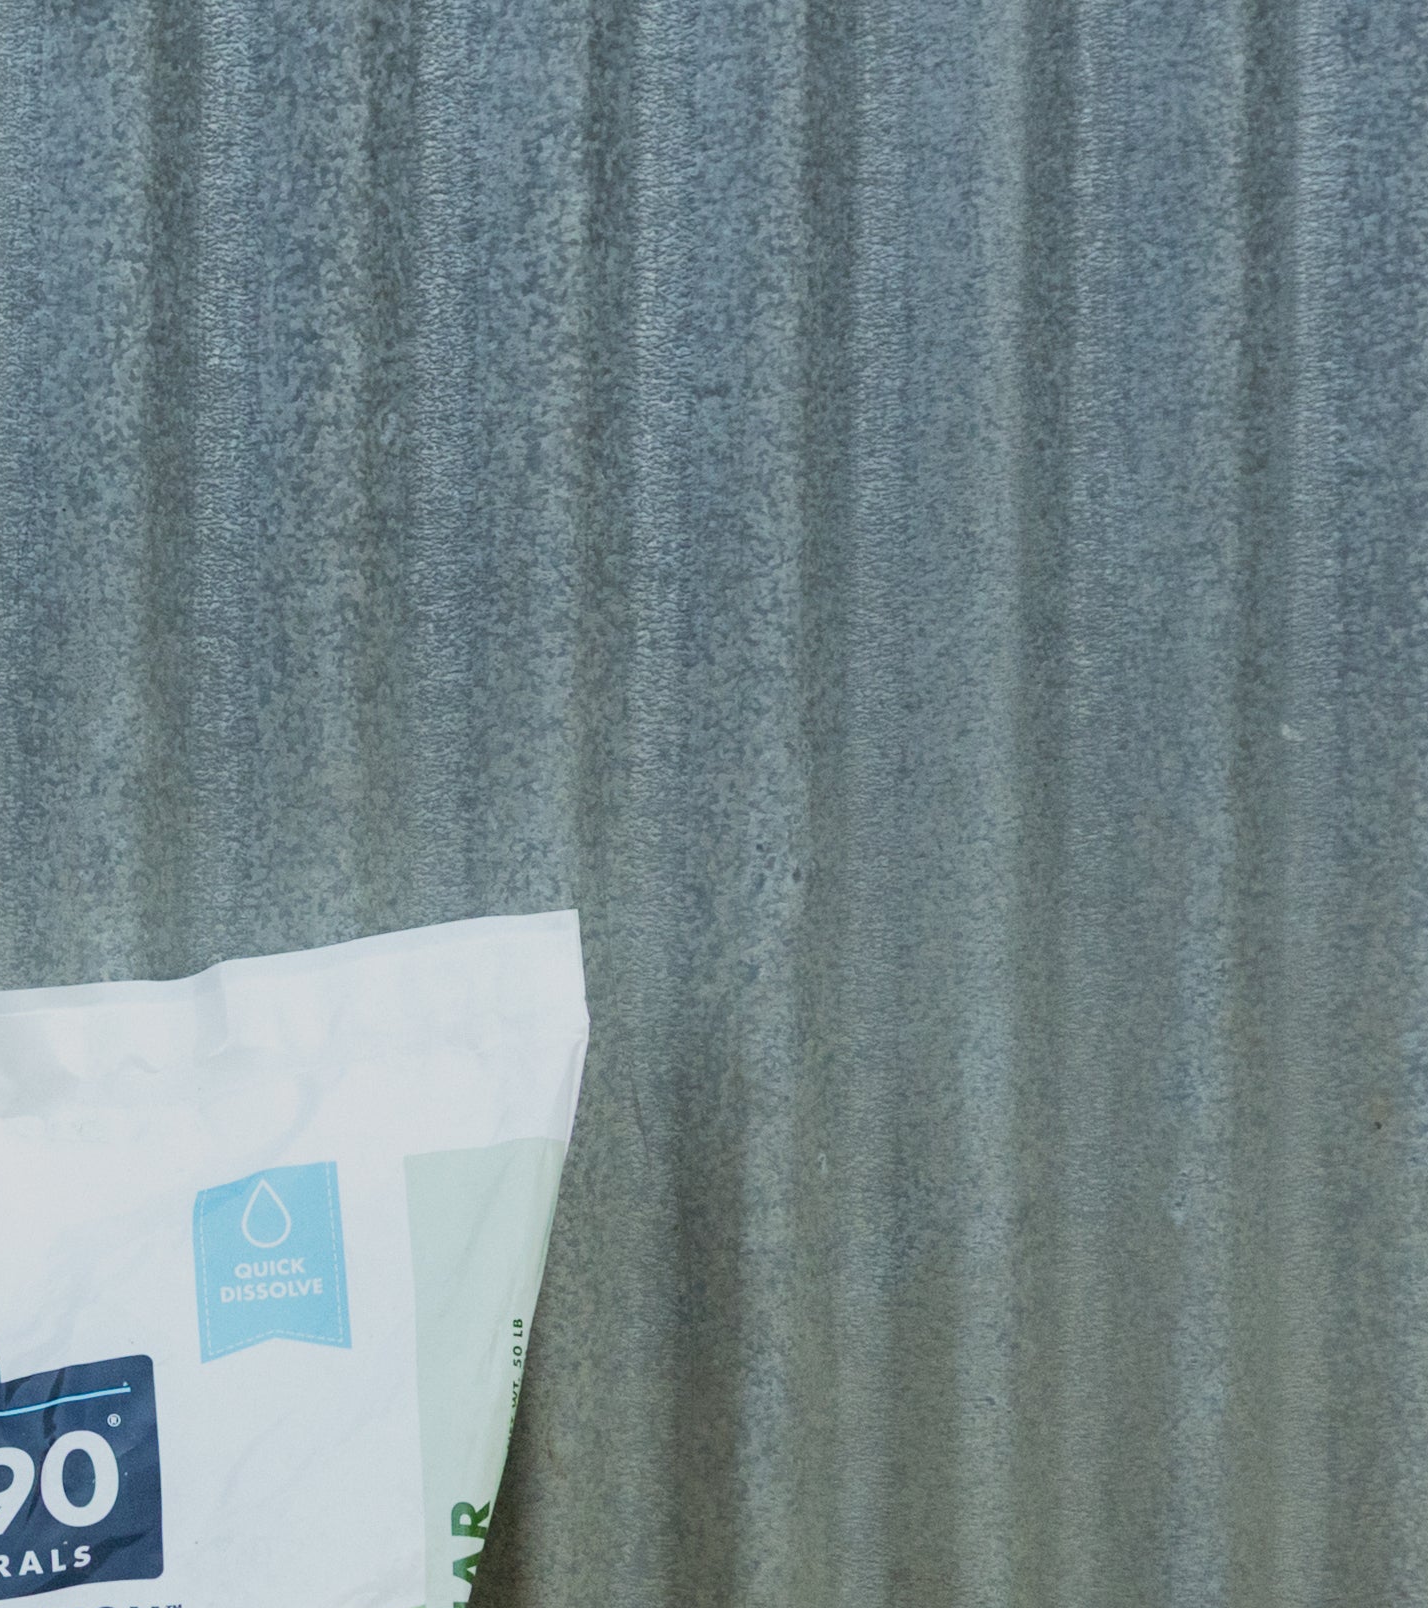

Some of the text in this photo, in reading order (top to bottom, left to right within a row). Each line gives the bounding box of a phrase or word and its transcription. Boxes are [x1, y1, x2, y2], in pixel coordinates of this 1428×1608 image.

[234, 1257, 306, 1279] QUICK
[220, 1278, 323, 1303] DISSOLVE
[513, 1318, 523, 1337] LB
[513, 1345, 523, 1368] 50
